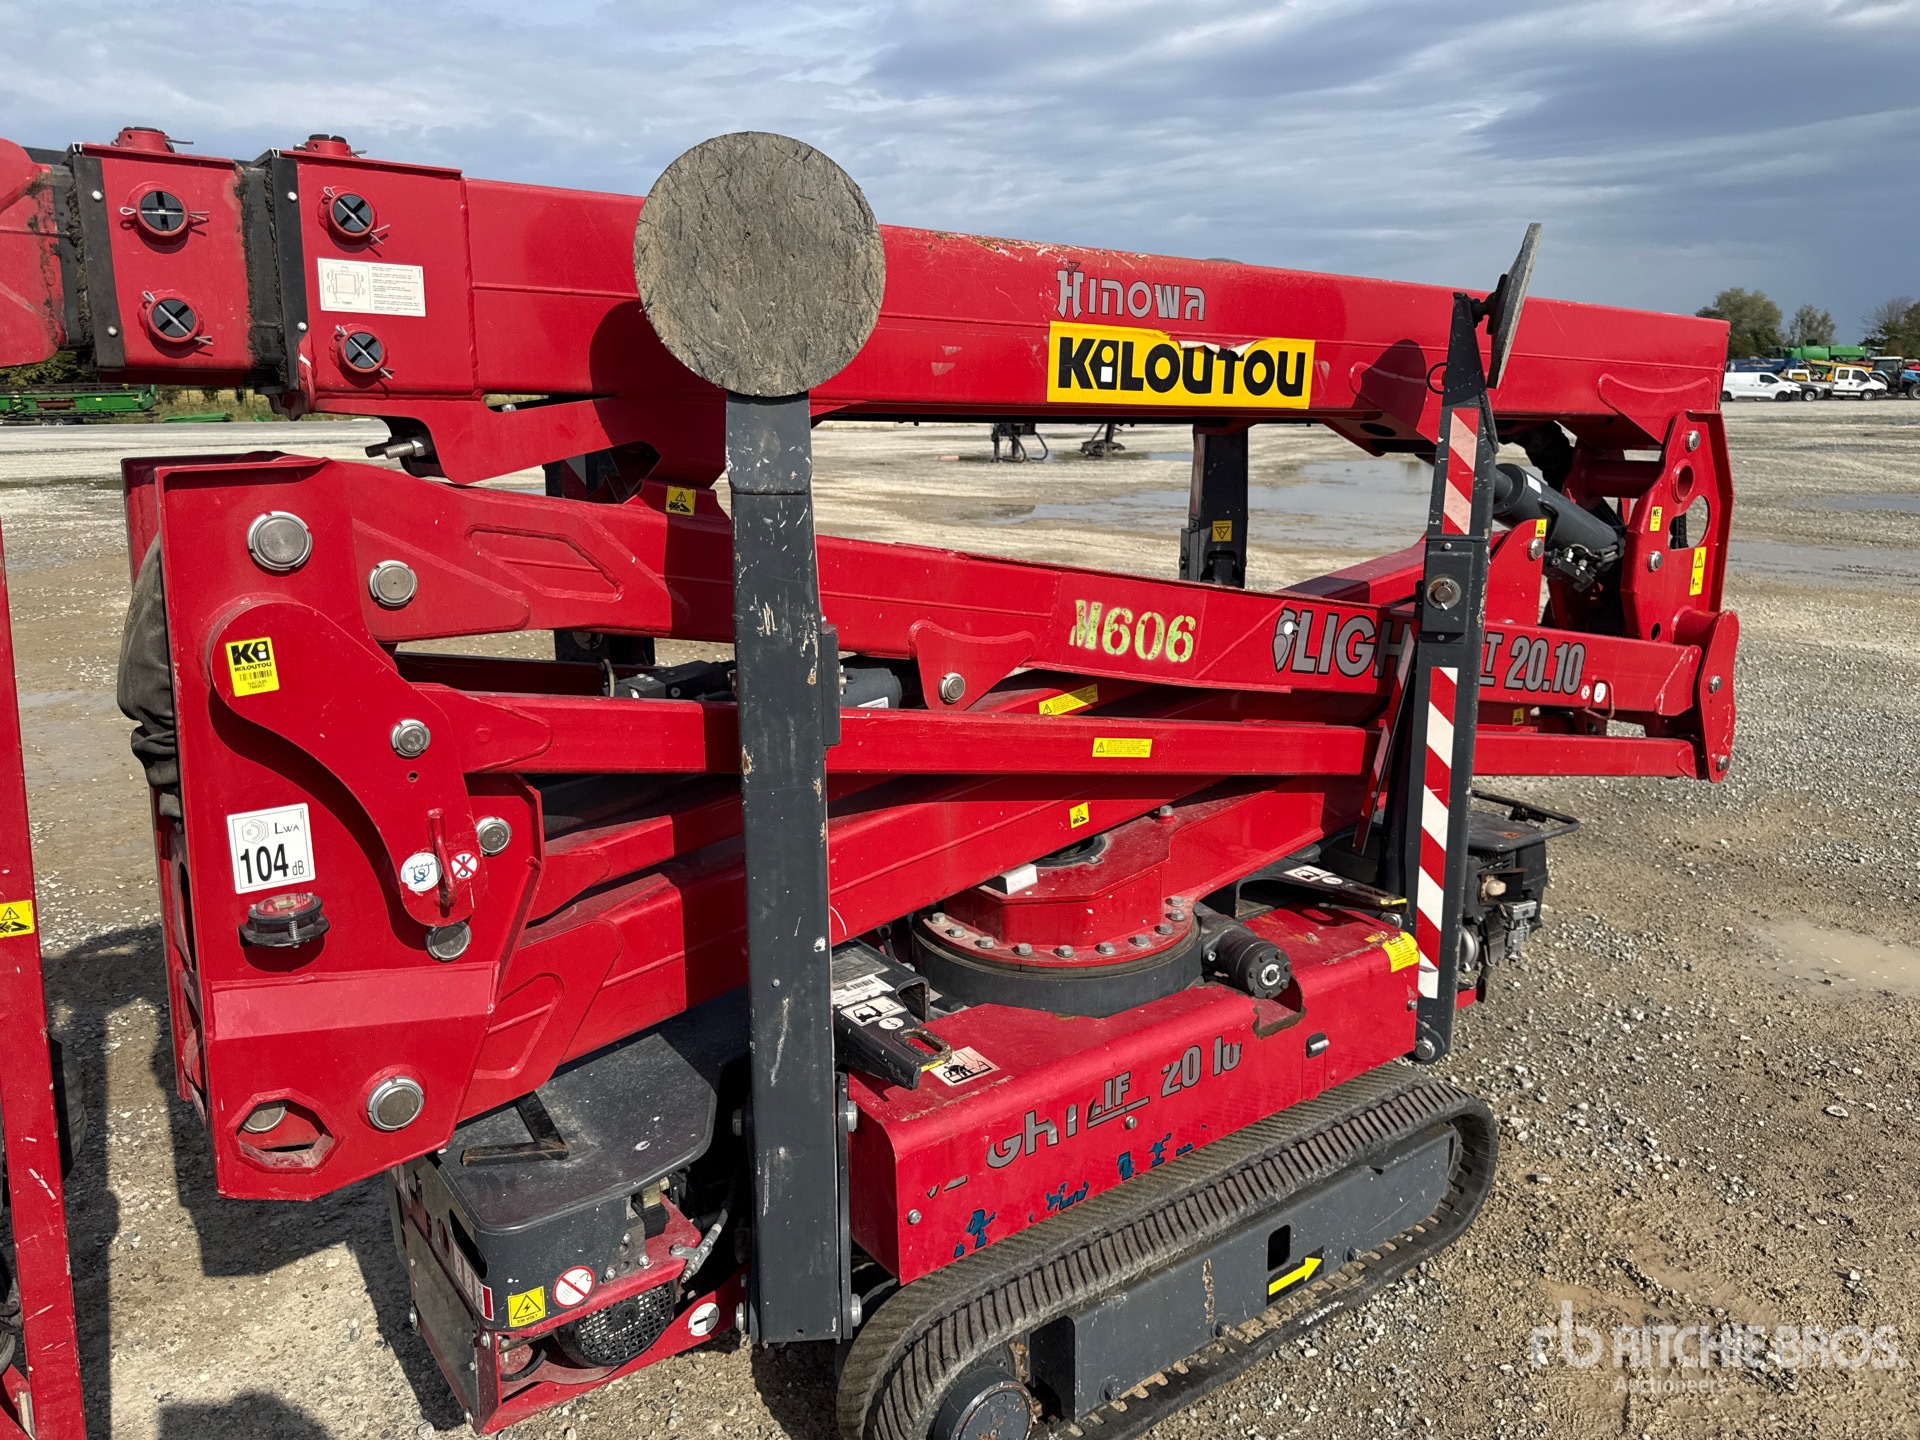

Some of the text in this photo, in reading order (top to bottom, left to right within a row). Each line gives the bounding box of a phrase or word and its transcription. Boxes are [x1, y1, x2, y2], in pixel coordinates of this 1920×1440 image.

[1504, 634, 1586, 695] 20.10
[240, 843, 305, 884] 104 dB
